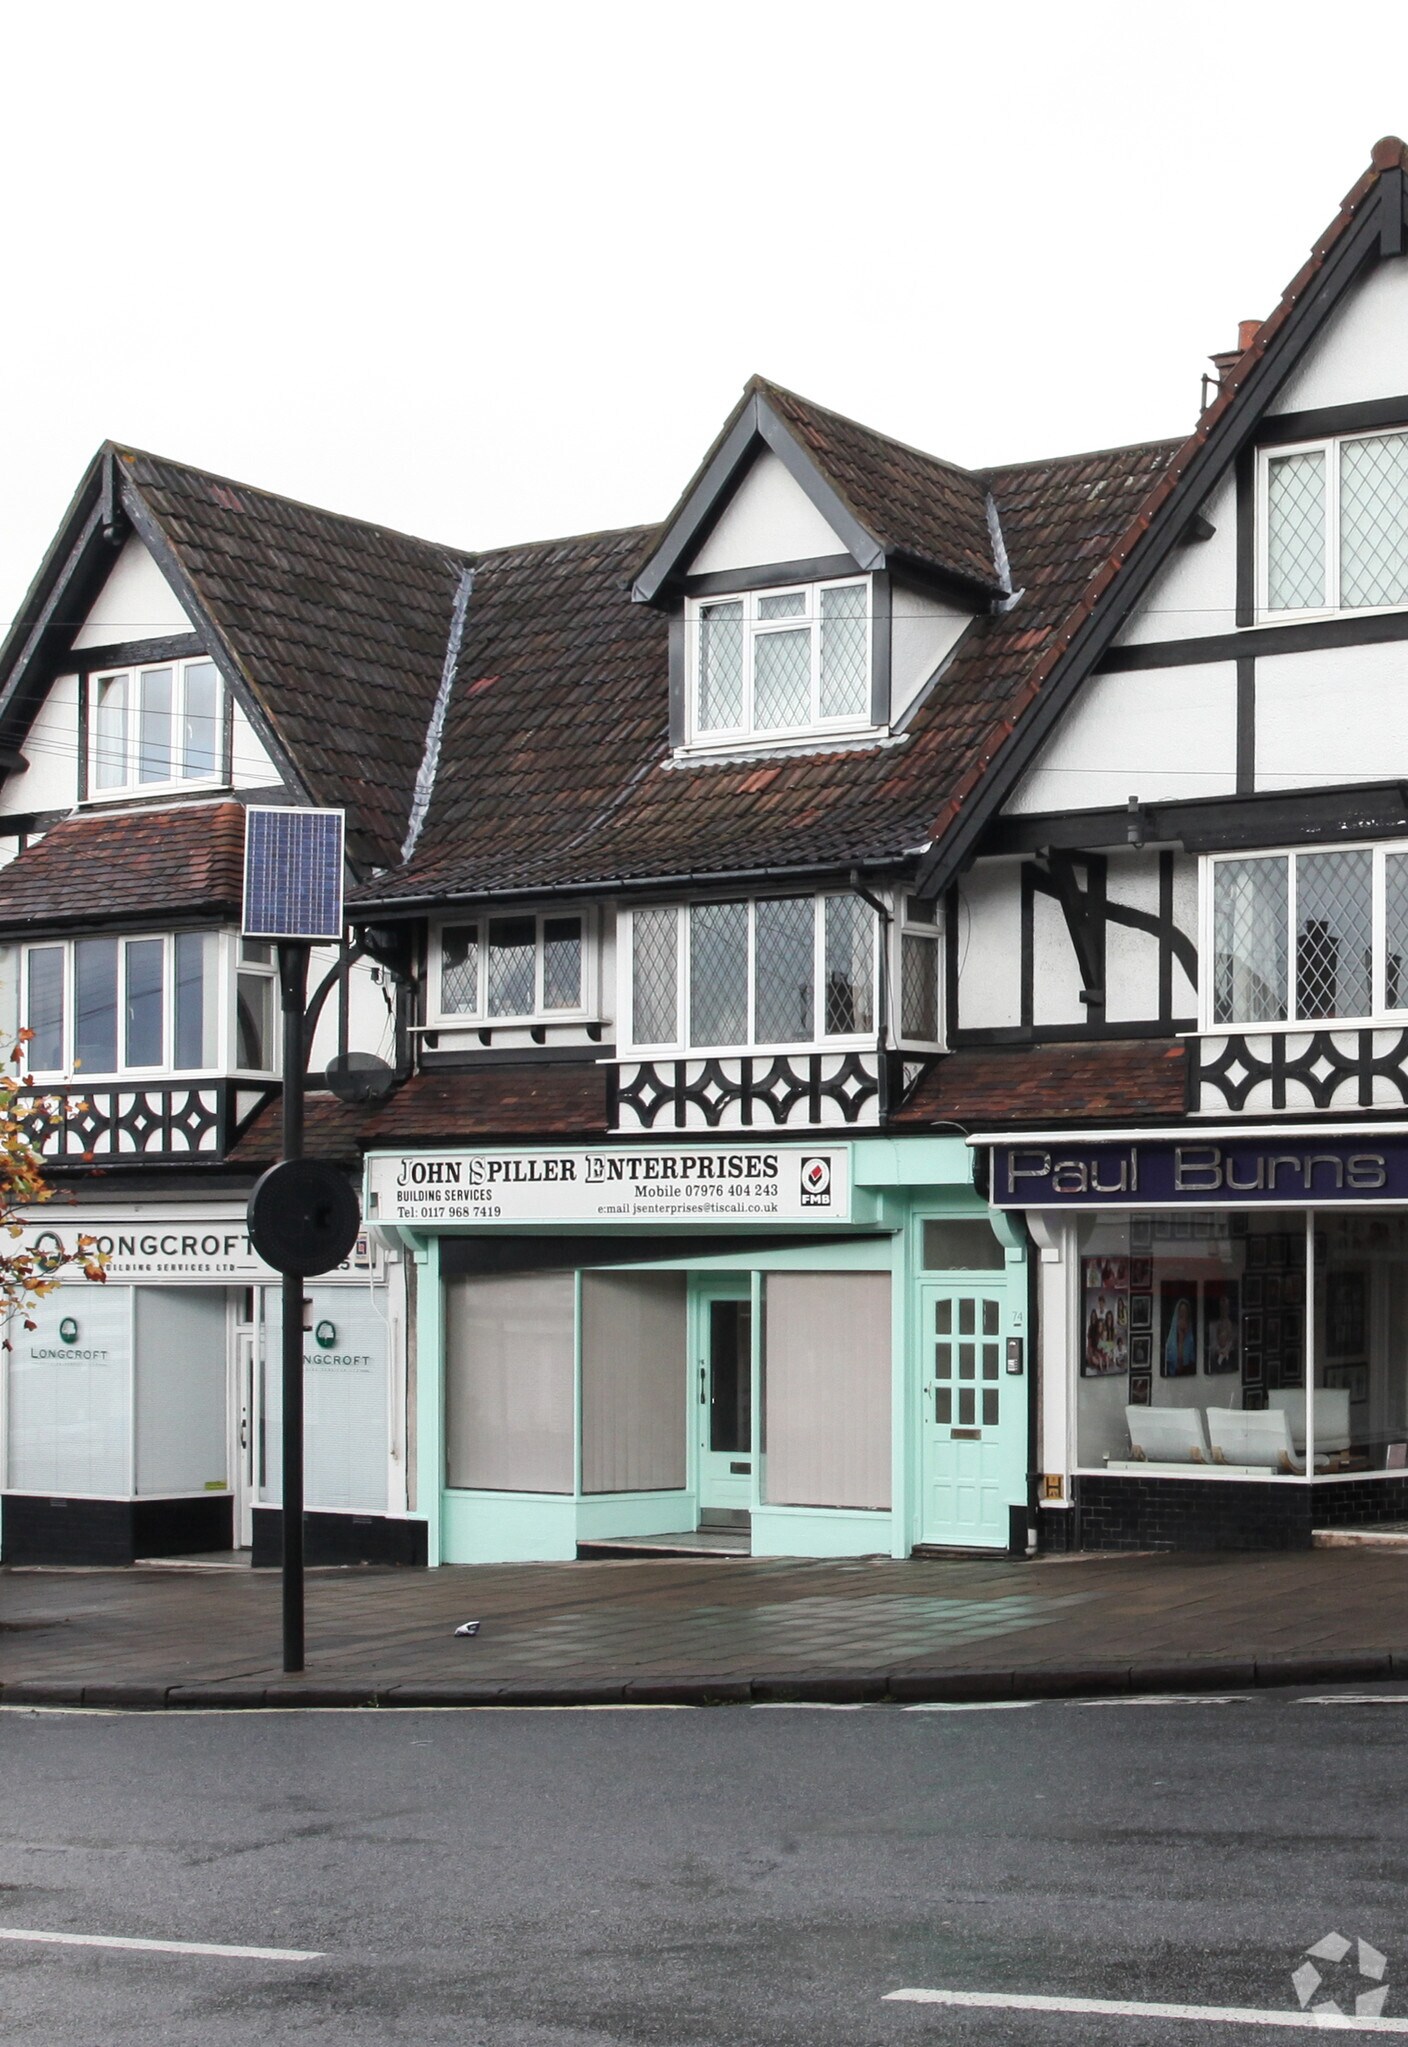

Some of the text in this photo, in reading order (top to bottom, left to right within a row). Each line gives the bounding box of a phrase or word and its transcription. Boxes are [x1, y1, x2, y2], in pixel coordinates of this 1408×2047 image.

[397, 1154, 779, 1186] JOHN SPILLER ENTERPRISES
[1008, 1146, 1386, 1193] Paul Burns
[397, 1189, 492, 1202] BUILDING SERVICES
[634, 1184, 778, 1198] Mobile 07976 404 243
[801, 1194, 830, 1205] FMB
[397, 1206, 501, 1218] Tel: 0117 968 7419
[632, 1201, 778, 1216] jsenterprises@tiscali.co.uk
[105, 1263, 236, 1272] UILDING SERVICES LTD
[1012, 1311, 1023, 1321] 74
[31, 1347, 108, 1360] LONGCROFT
[303, 1354, 370, 1366] NGCROFT
